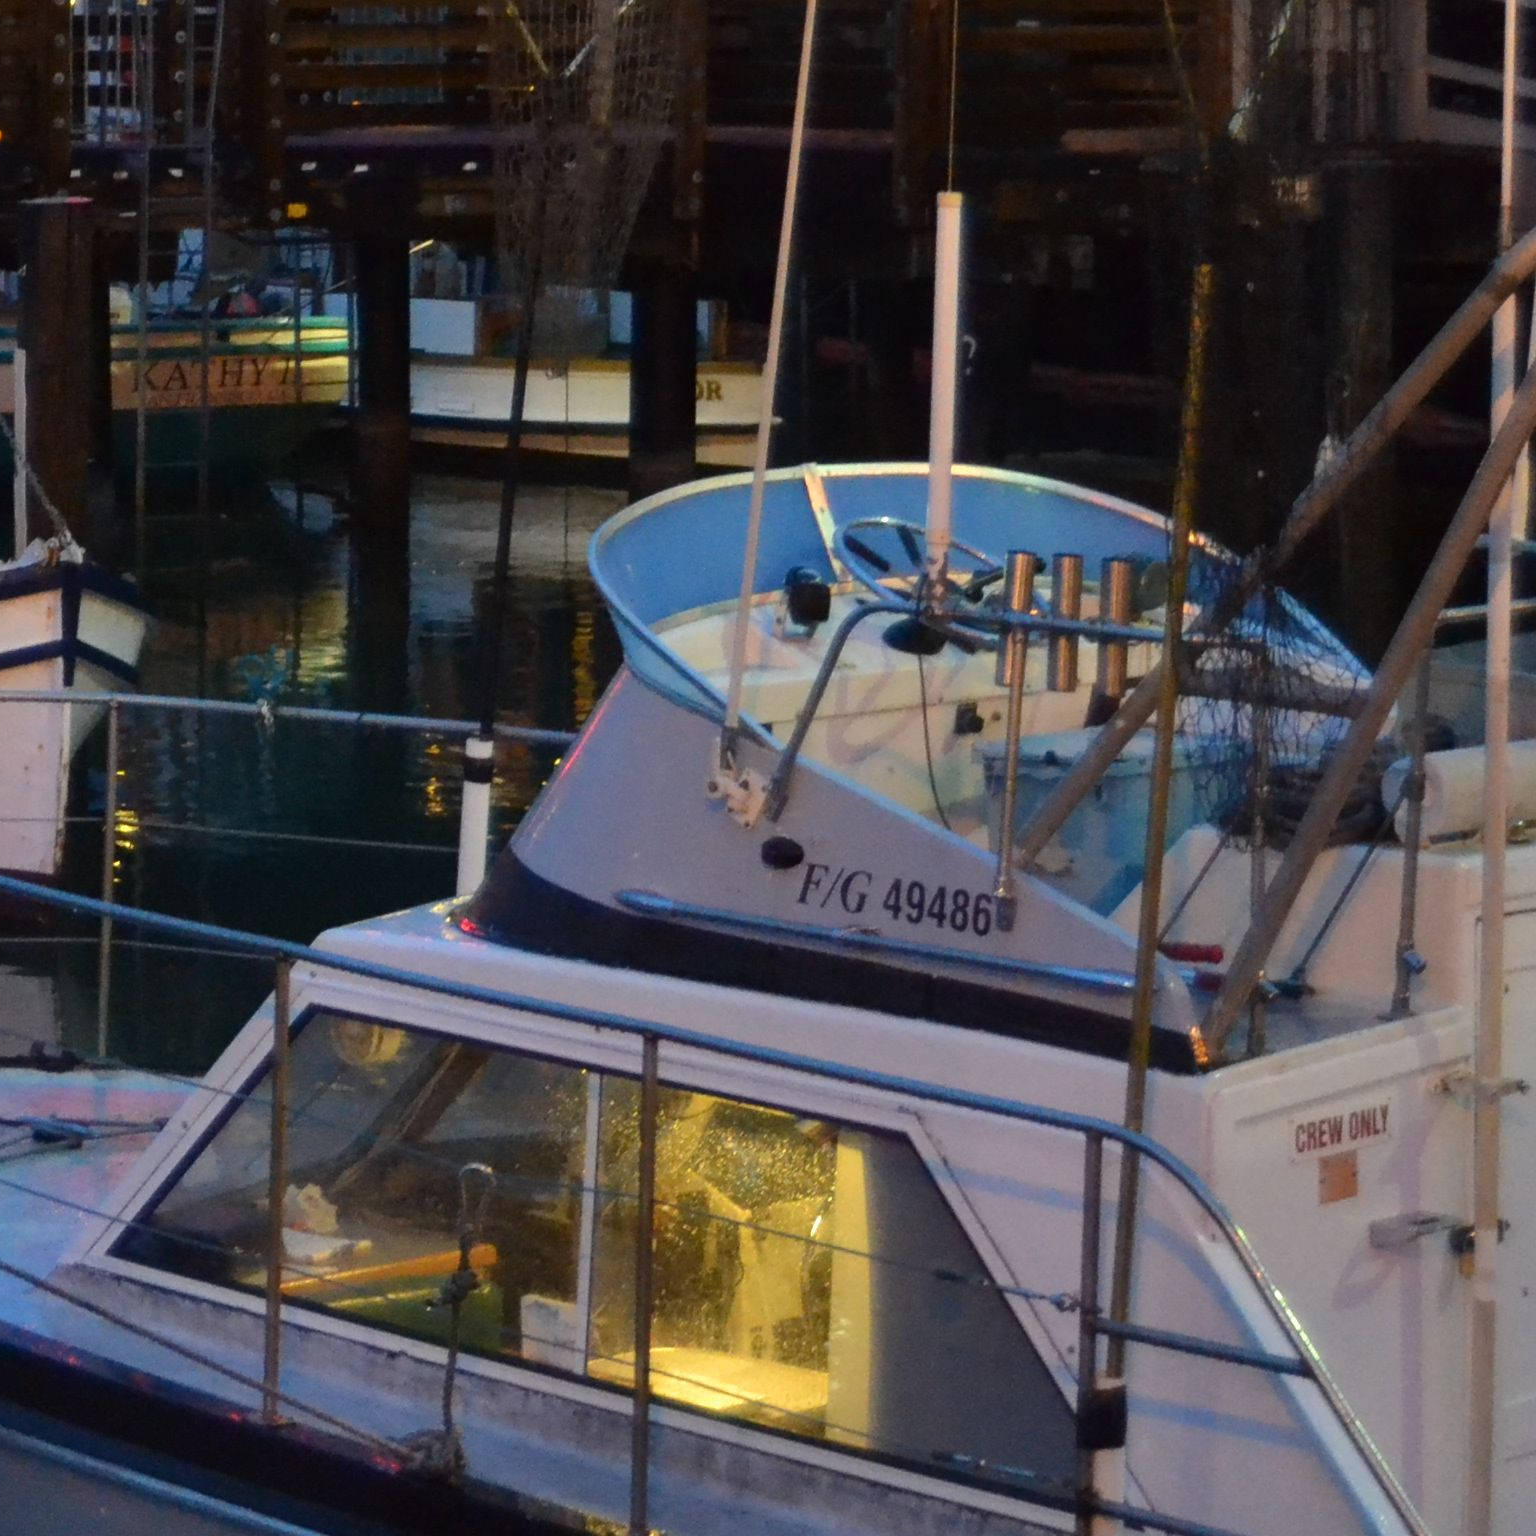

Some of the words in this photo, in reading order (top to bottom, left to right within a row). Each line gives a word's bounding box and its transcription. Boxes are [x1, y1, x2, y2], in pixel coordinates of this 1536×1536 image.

[798, 864, 872, 914] F/G
[883, 877, 992, 937] 49486
[1295, 1115, 1344, 1153] CREW
[1349, 1104, 1389, 1141] ONLY
